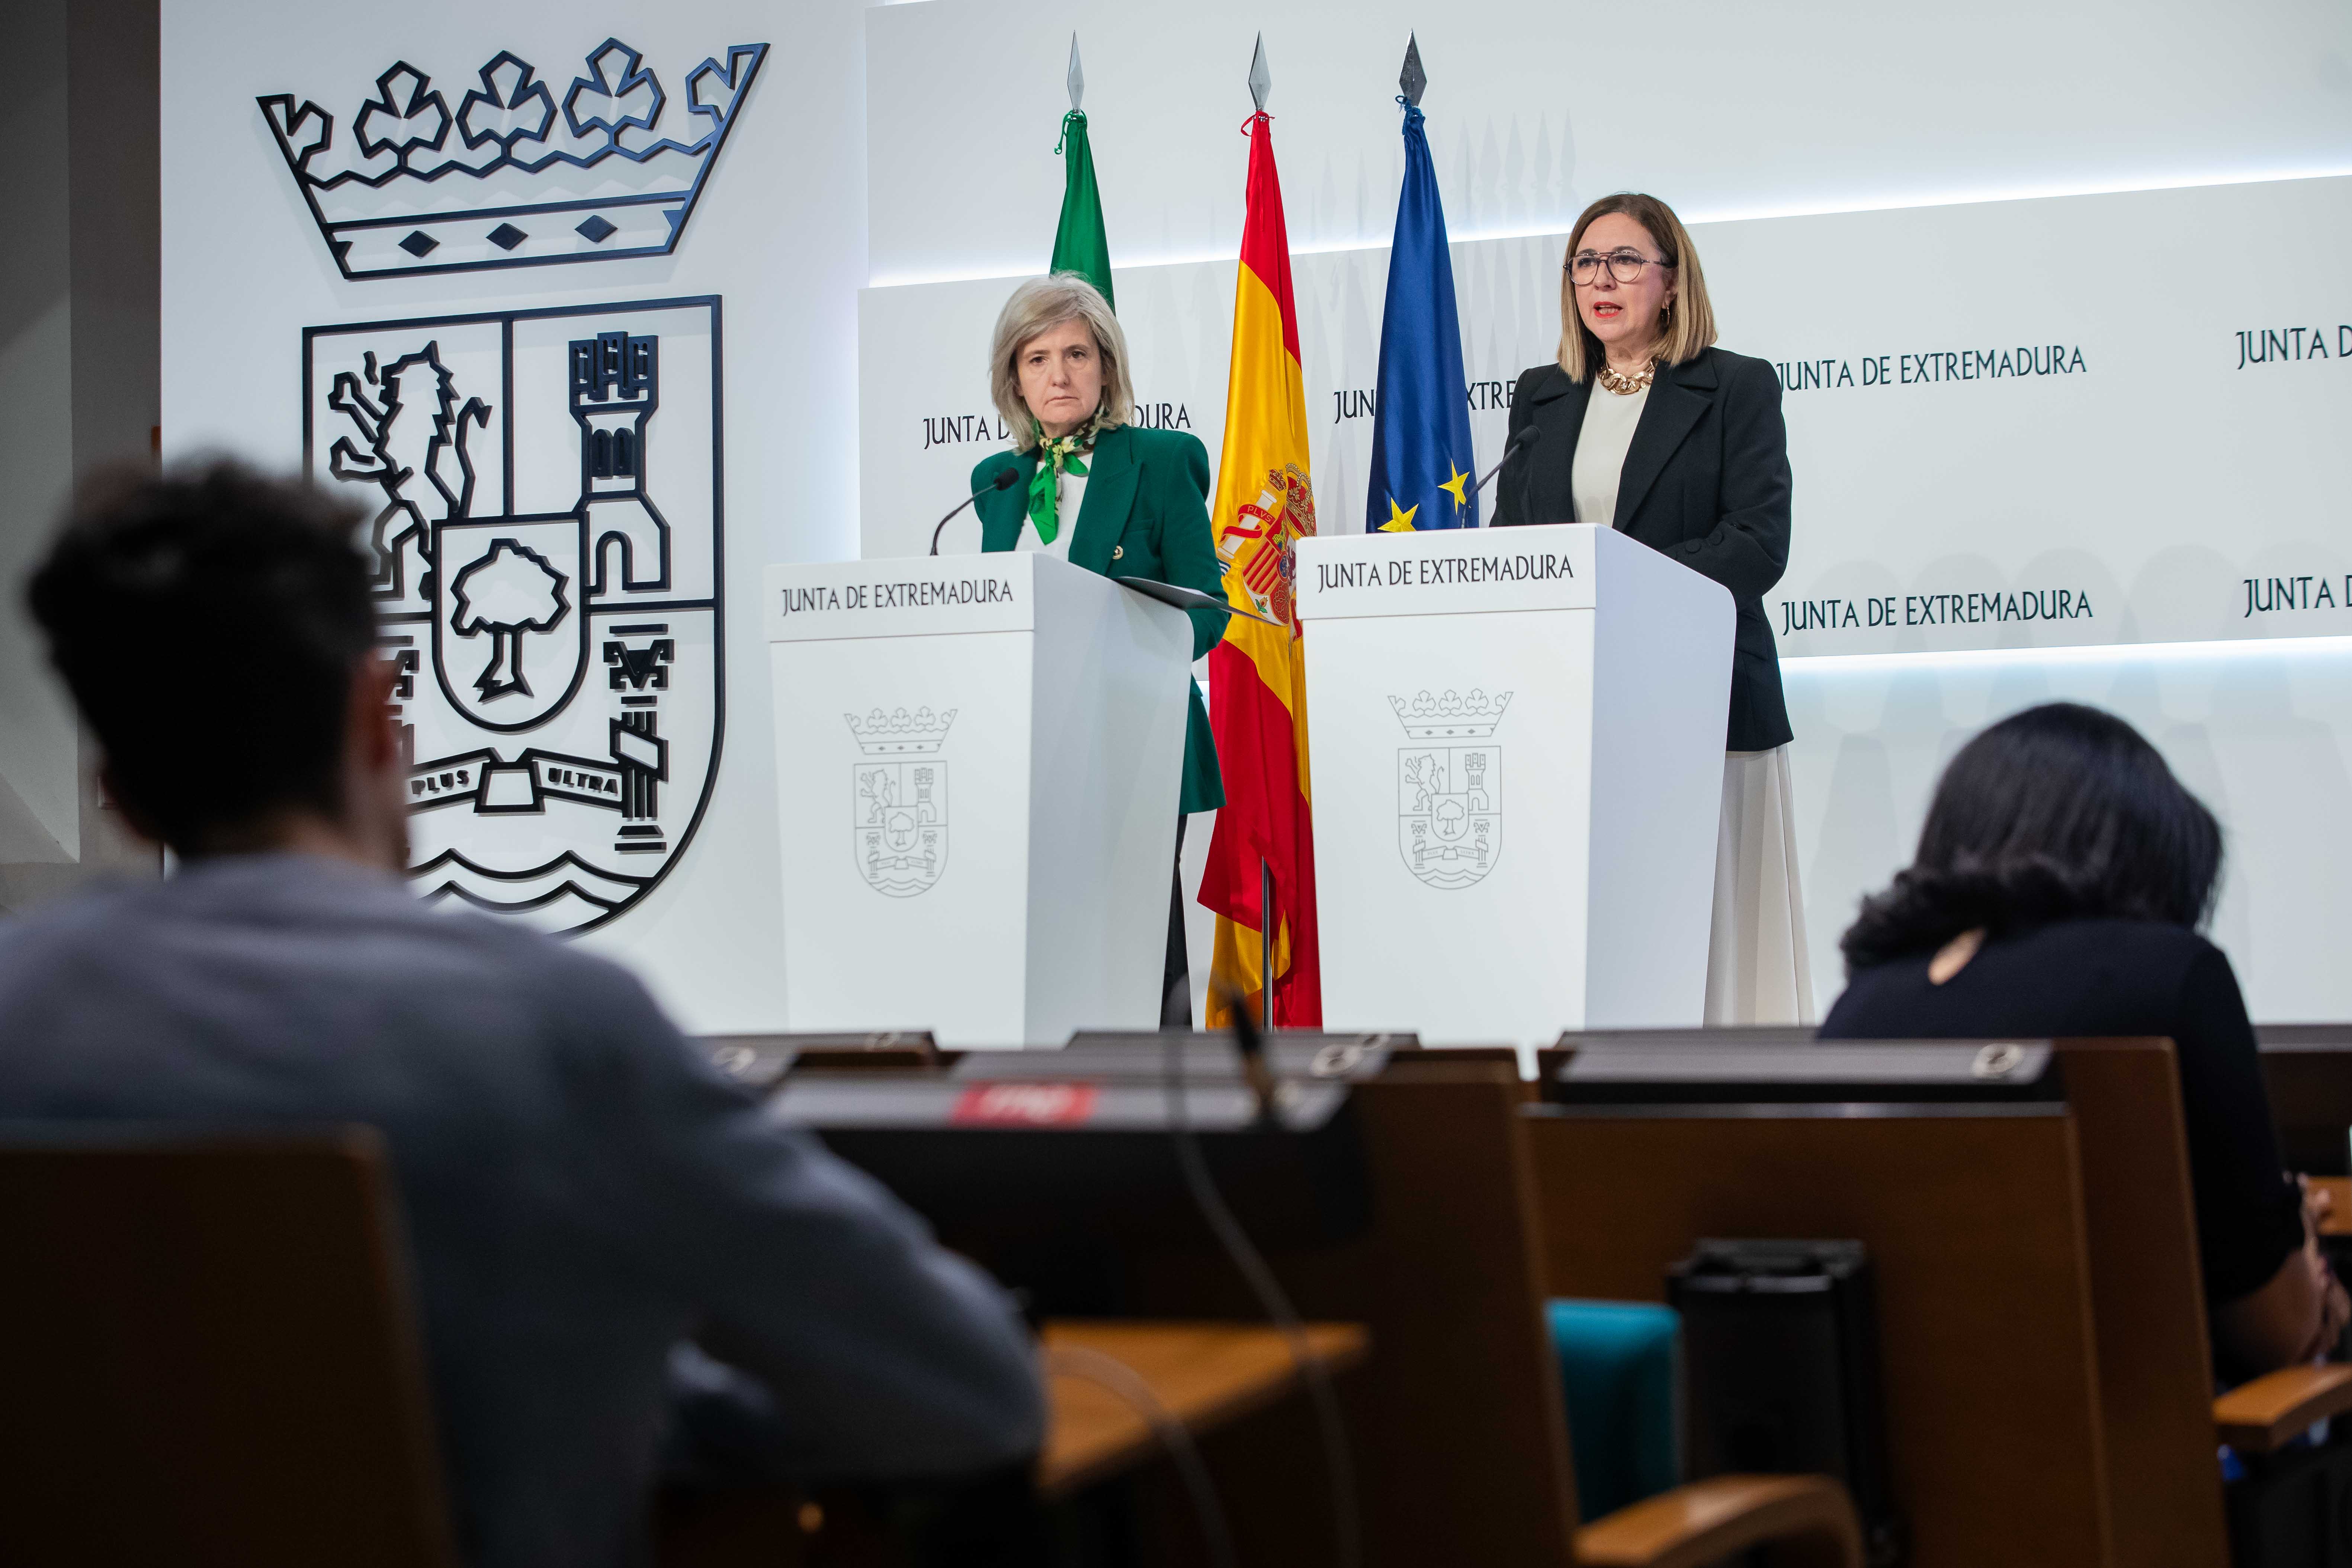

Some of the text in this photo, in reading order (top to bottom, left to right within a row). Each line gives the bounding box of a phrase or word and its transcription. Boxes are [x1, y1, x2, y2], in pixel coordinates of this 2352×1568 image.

[2235, 325, 2352, 370] JUNTA D
[1776, 345, 2087, 392] JUNTA DE EXTREMADURA
[1333, 389, 1375, 424] JUN
[922, 415, 991, 450] JUNTA
[1247, 506, 1273, 522] PLVS
[1317, 554, 1574, 593] JUNTA DE EXTREMADURA
[782, 579, 1013, 617] JUNTA DE EXTREMADURA
[1781, 589, 2093, 637] JUNTA DE EXTREMADURA
[2242, 576, 2336, 618] JUNTA
[411, 767, 619, 795] PLUS ULTRA
